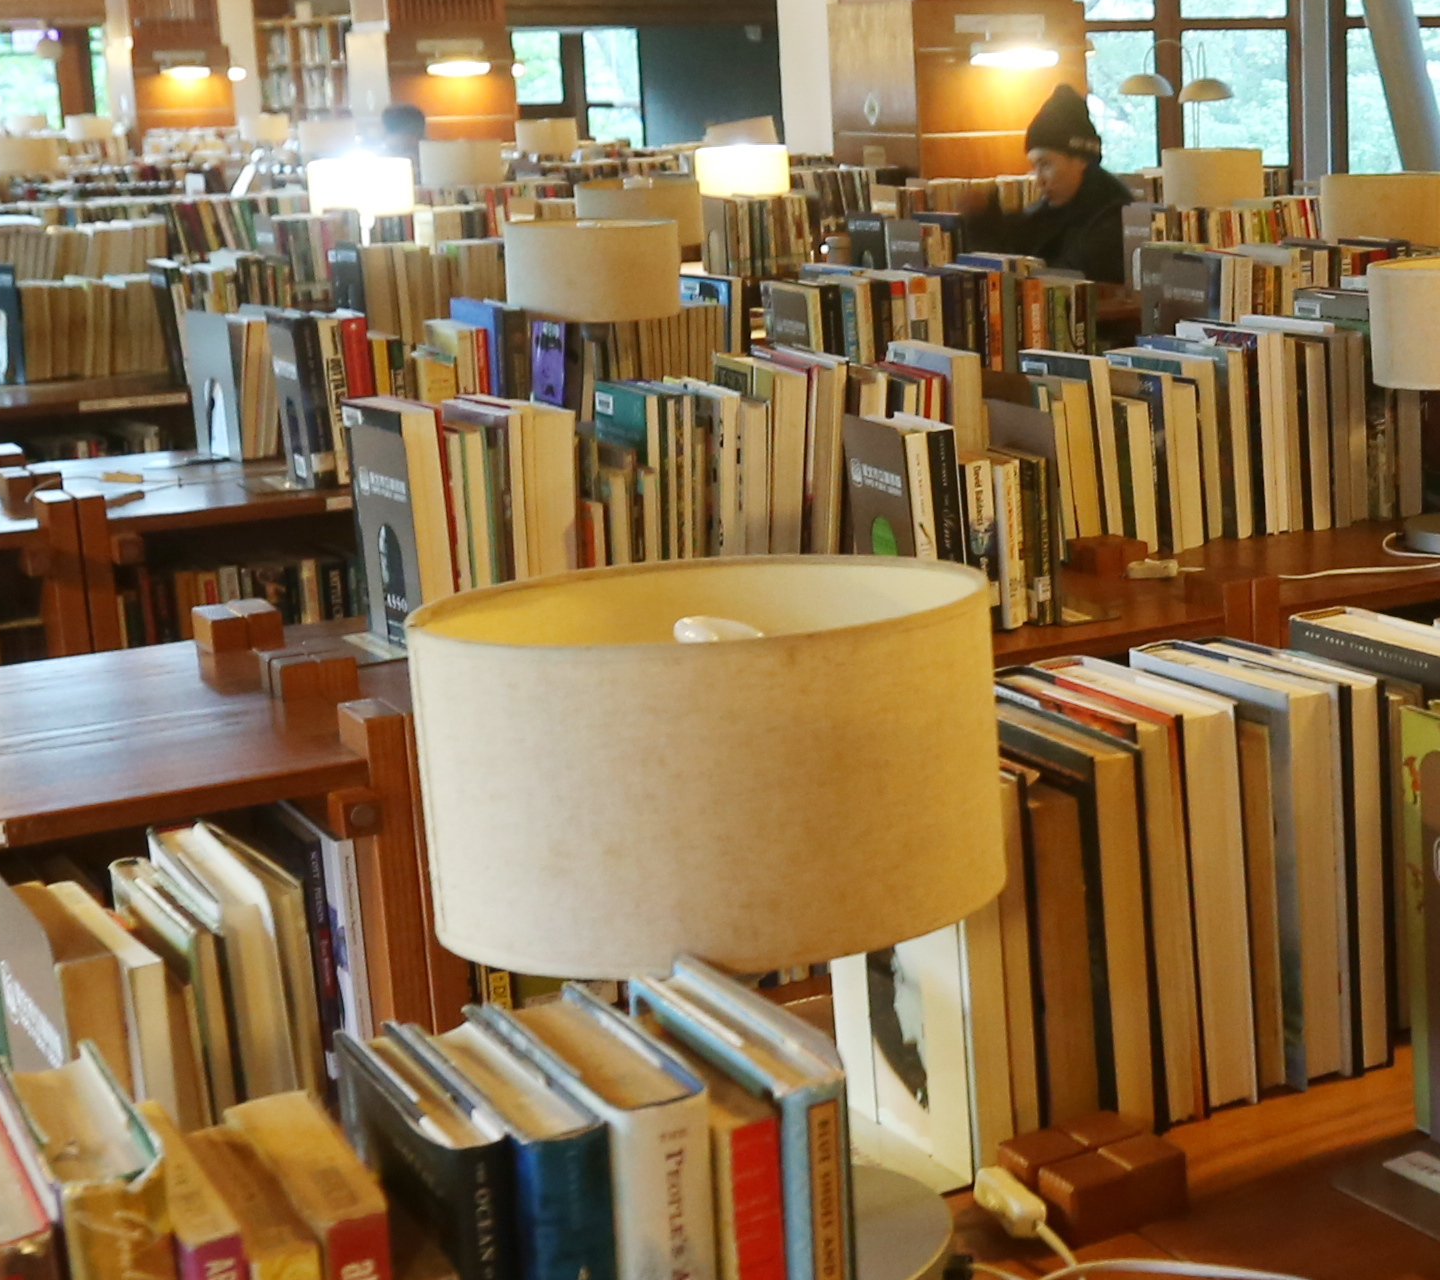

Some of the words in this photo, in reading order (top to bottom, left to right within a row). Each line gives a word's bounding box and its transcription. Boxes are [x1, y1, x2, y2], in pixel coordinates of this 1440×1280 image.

[971, 464, 982, 488] David
[973, 490, 985, 527] Baldacci
[815, 1118, 831, 1164] BLUE
[665, 1147, 686, 1256] PEOPLE'S
[817, 1171, 835, 1229] SHOES
[472, 1187, 493, 1263] OCEAN
[820, 1234, 836, 1277] AND
